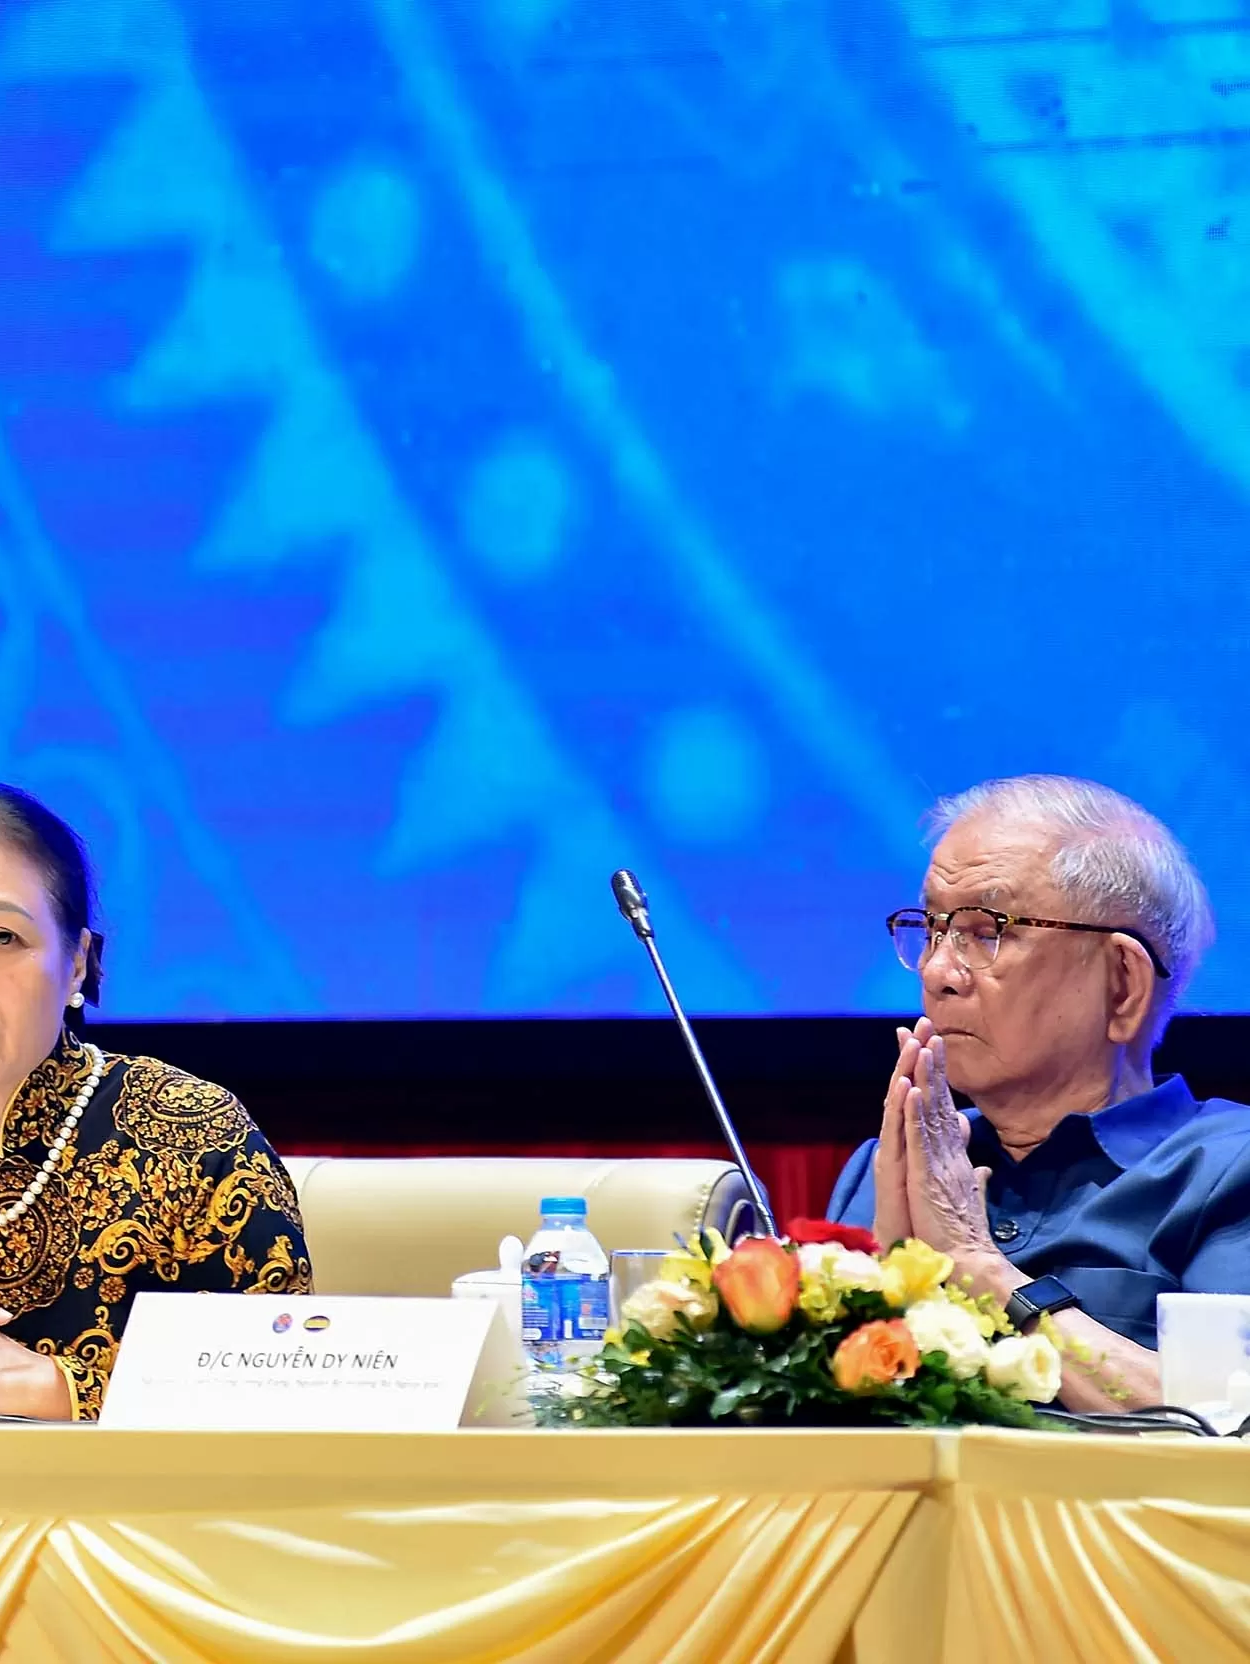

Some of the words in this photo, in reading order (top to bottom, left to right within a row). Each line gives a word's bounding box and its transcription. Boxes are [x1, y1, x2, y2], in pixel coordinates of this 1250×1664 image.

[197, 1351, 234, 1371] Đ/C
[237, 1346, 318, 1370] NGUYỄN
[321, 1352, 348, 1370] DY
[353, 1349, 399, 1370] NIÊN
